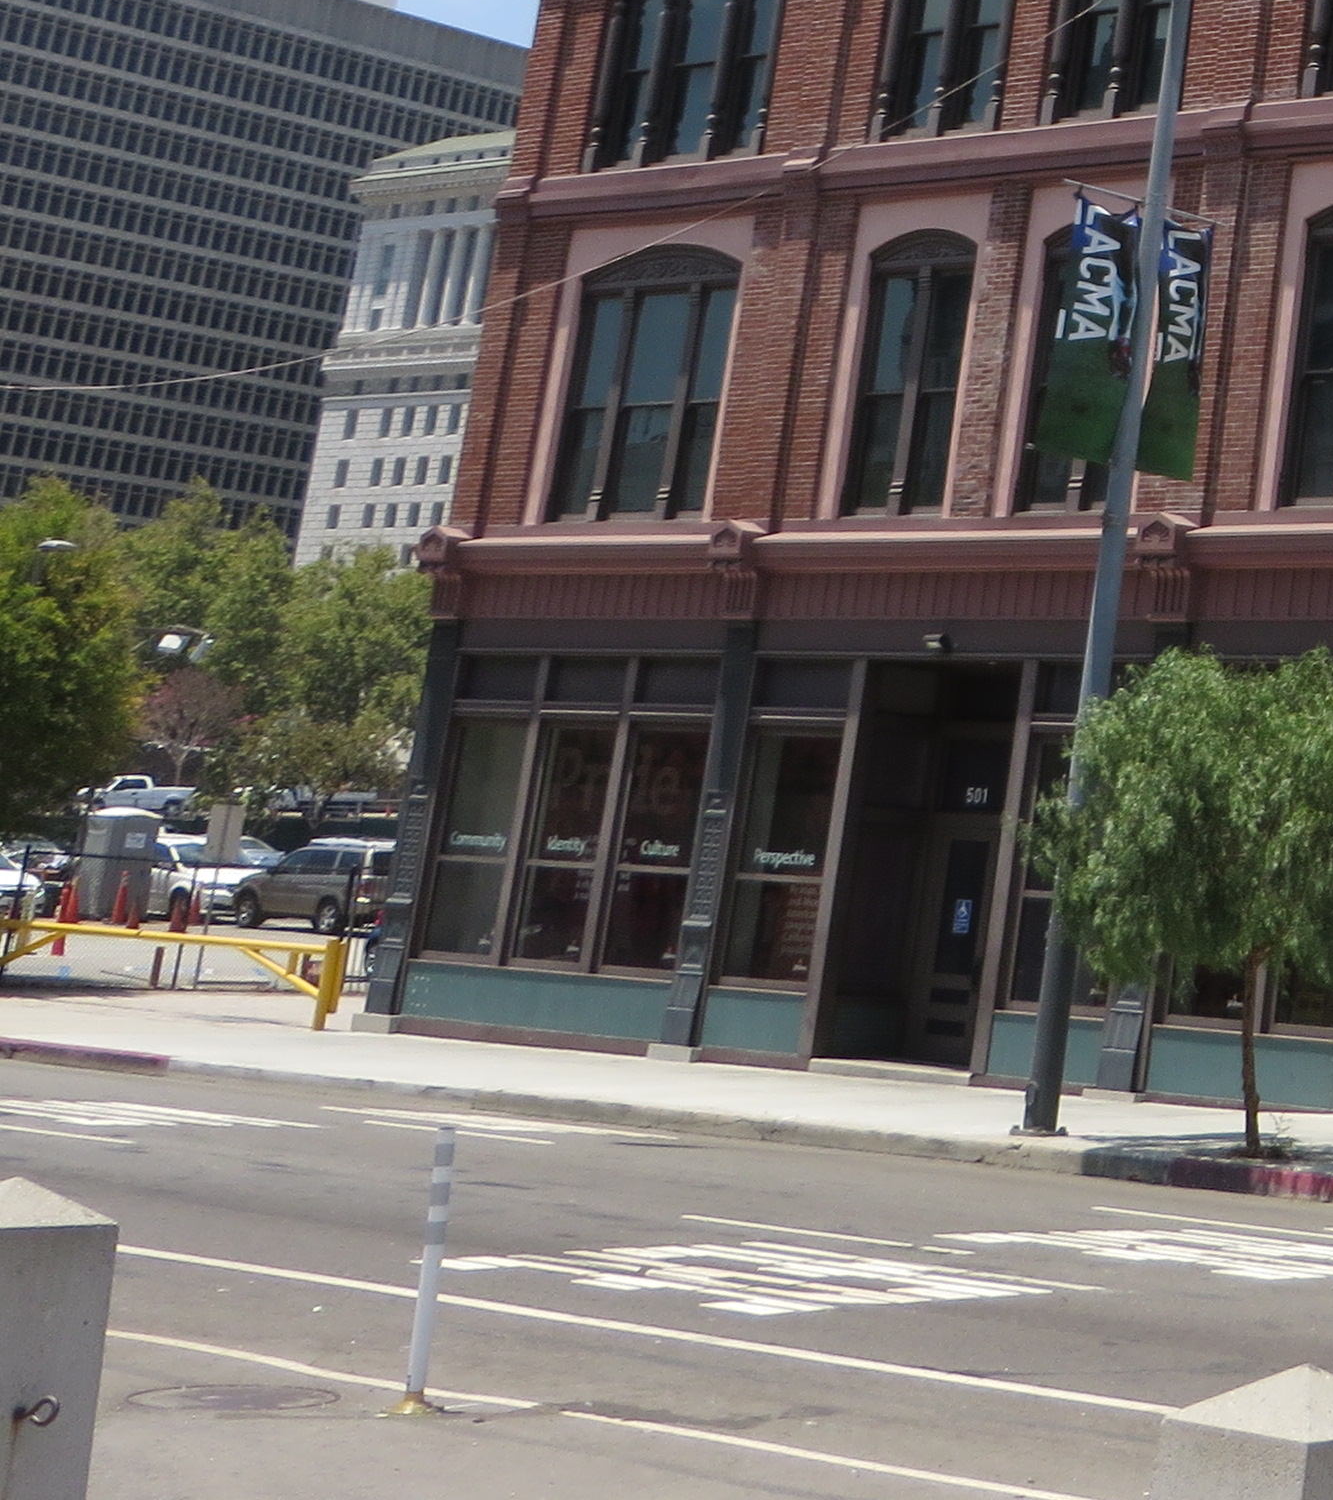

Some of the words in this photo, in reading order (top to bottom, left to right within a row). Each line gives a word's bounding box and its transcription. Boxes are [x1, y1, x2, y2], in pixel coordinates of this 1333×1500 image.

[1067, 204, 1122, 341] LACMA
[1163, 230, 1202, 363] LACMA
[965, 787, 989, 803] 501
[451, 831, 507, 853] Community
[547, 834, 588, 856] Identity
[639, 839, 681, 857] Culture
[754, 847, 816, 869] Perspective
